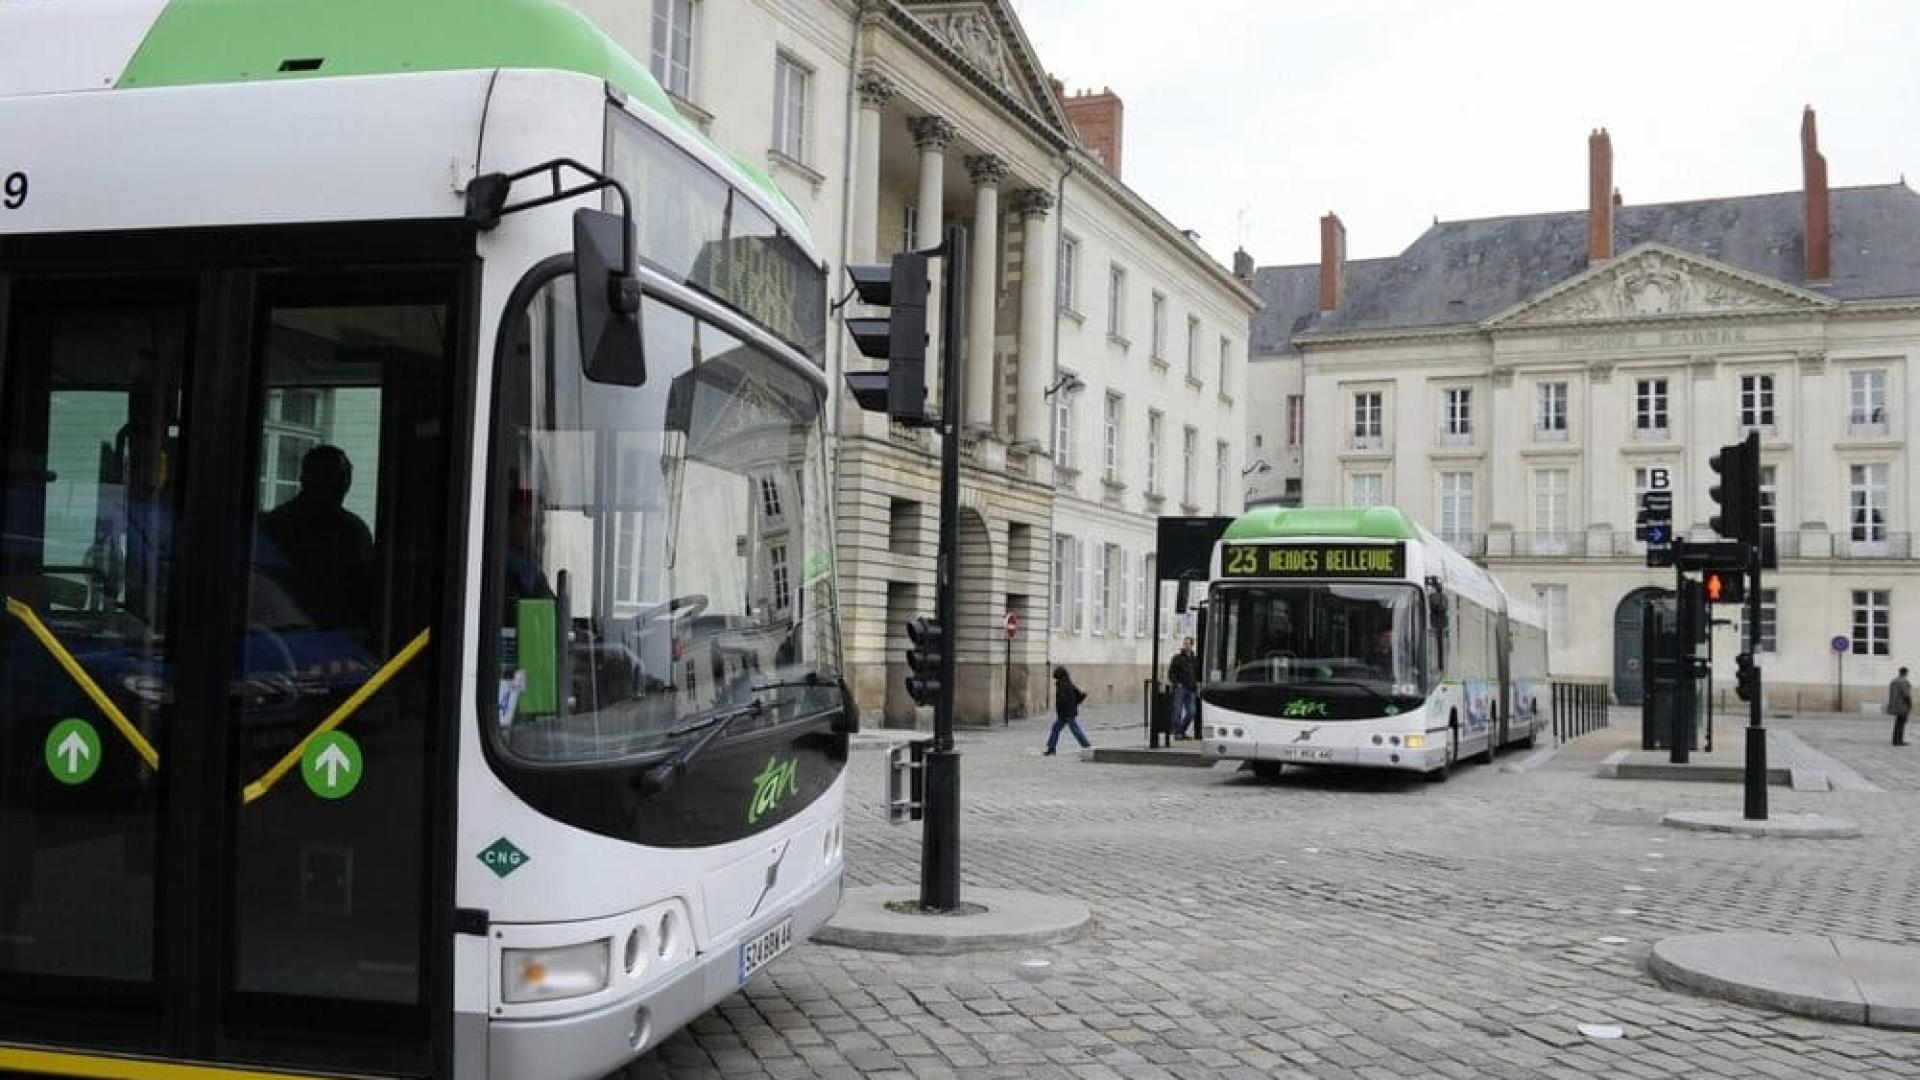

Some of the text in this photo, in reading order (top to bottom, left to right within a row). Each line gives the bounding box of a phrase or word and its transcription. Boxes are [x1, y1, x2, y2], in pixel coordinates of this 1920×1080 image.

[4, 171, 28, 210] 9
[1651, 469, 1669, 489] B
[1228, 546, 1257, 573] 23
[1326, 549, 1393, 571] BELLEVUE
[485, 851, 521, 864] CNG
